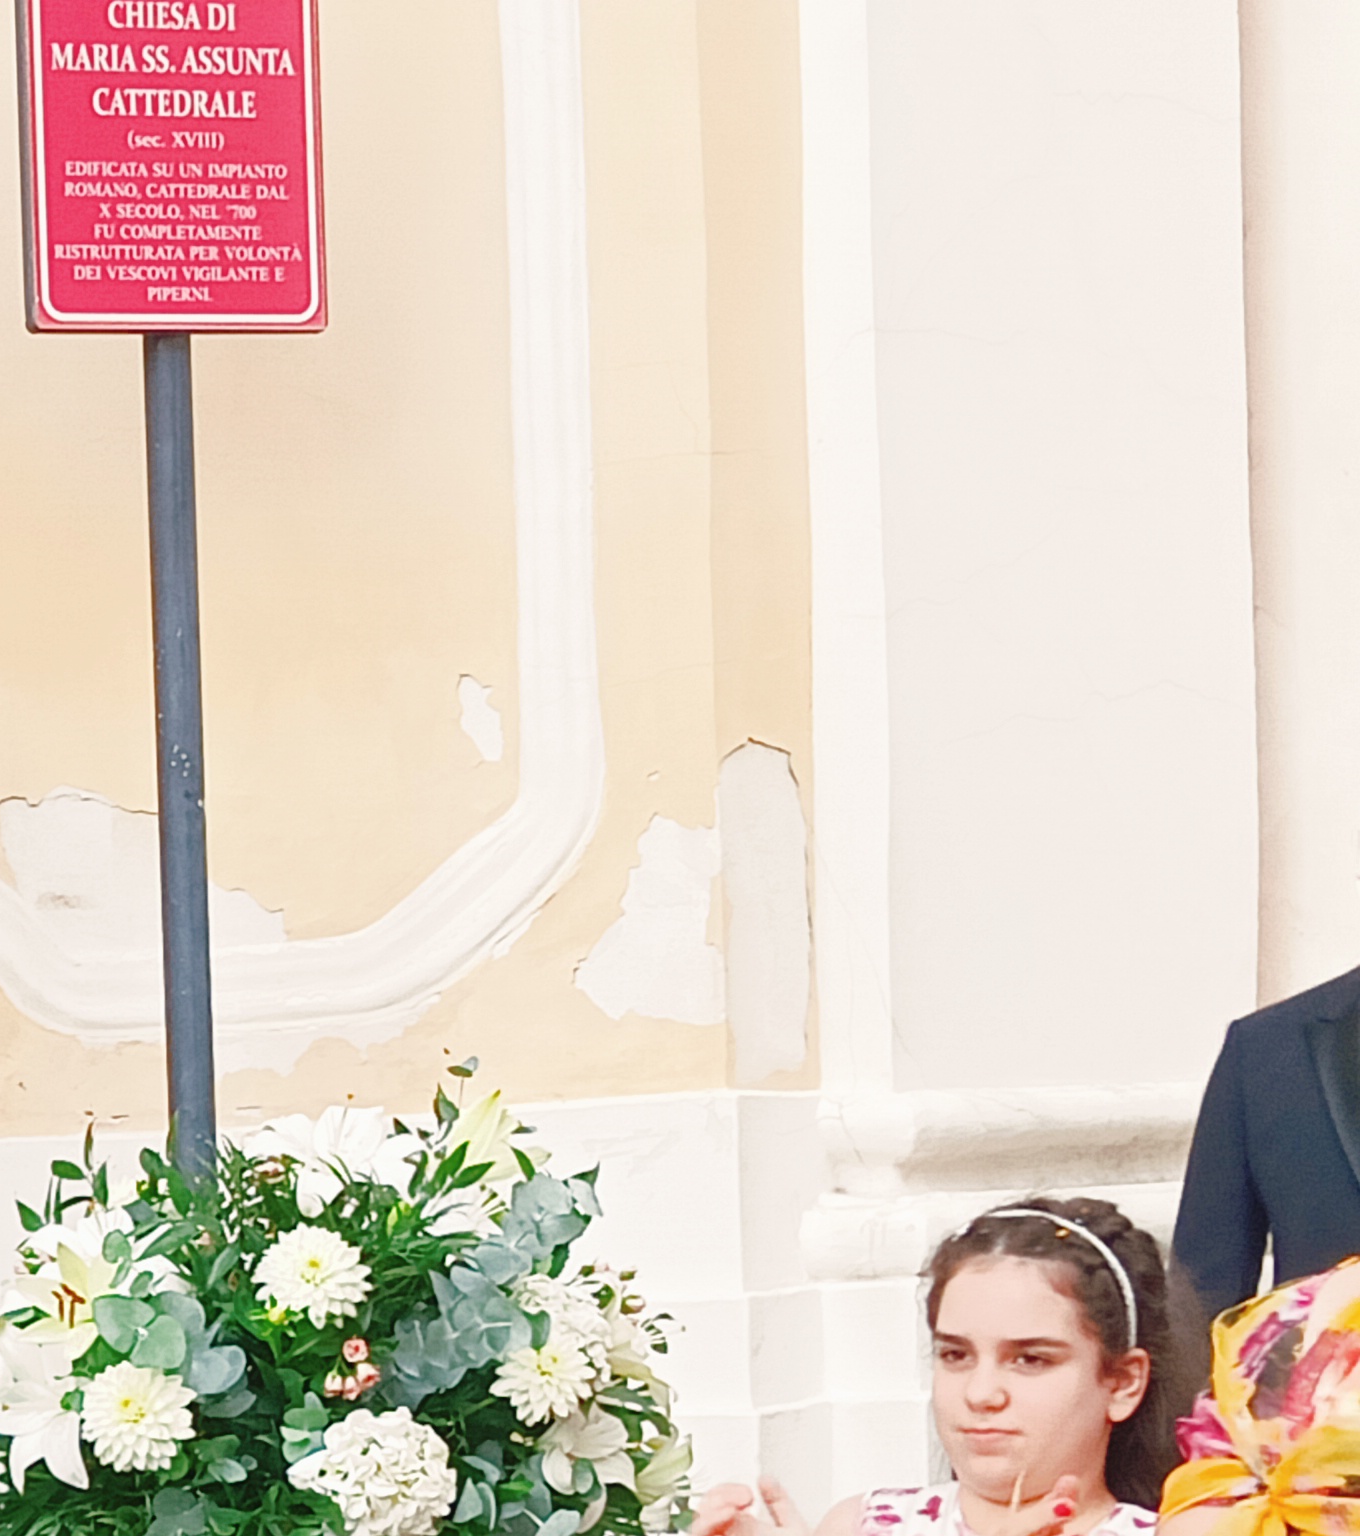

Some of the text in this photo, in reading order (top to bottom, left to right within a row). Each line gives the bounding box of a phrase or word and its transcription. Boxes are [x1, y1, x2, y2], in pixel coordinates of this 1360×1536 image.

[107, 0, 236, 31] CHIESA DI
[50, 42, 296, 76] MARIA SS. ASSUNTA
[92, 87, 257, 118] CATTEDRALE
[127, 130, 225, 151] (sec. XVIII)
[65, 161, 288, 180] EDIFICATA SU UN IMPIANTO
[64, 182, 289, 200] ROMANO, CATTEDRALE DAL
[98, 203, 112, 219] X
[116, 203, 184, 221] SECOLO,
[189, 204, 220, 220] NEL
[93, 223, 262, 241] FU COMPLETAMENTE
[54, 243, 302, 261] RISTRUTTURATA PER VOLONTÀ
[74, 265, 285, 282] DEI VESCOVI VIGILANTE E
